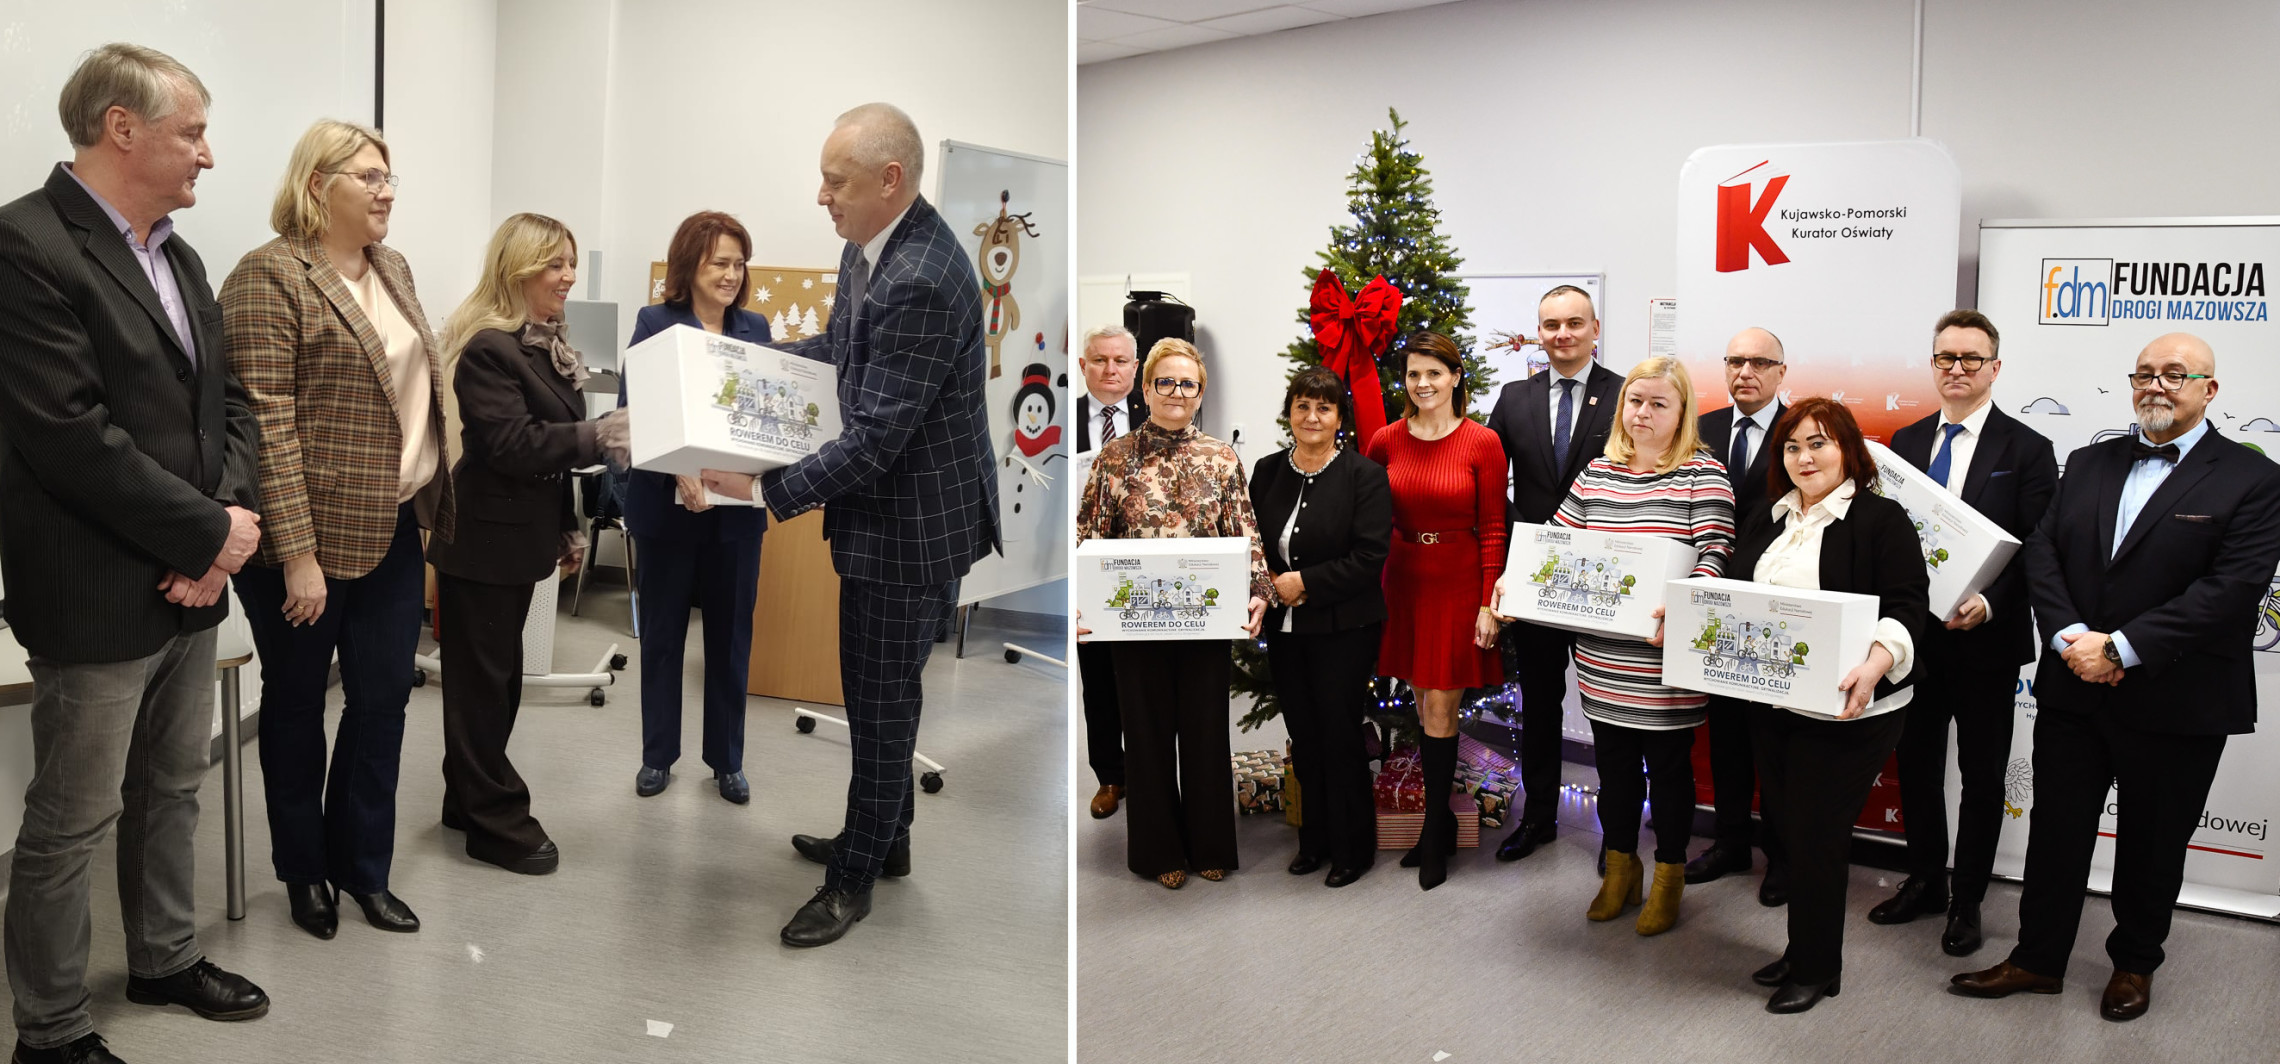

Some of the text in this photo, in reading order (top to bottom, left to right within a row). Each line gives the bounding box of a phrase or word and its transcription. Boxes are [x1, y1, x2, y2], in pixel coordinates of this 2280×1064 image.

[1780, 206, 1907, 222] Kujawsko-Pomorski
[1791, 225, 1894, 240] Kurator Oświaty
[2113, 262, 2266, 297] FUNDACJA
[2112, 300, 2268, 321] DROGI MAZOWSZA
[730, 427, 774, 444] ROWEREM
[776, 437, 788, 447] DO
[790, 440, 810, 451] CELU
[1113, 558, 1141, 566] FUNDACJA
[1704, 591, 1731, 602] FUNDACJA
[1537, 599, 1616, 617] ROWEREM DO CELU
[1184, 620, 1206, 628] CELU
[1704, 668, 1791, 690] ROWEREM DO CELU
[2197, 810, 2268, 841] dowej
